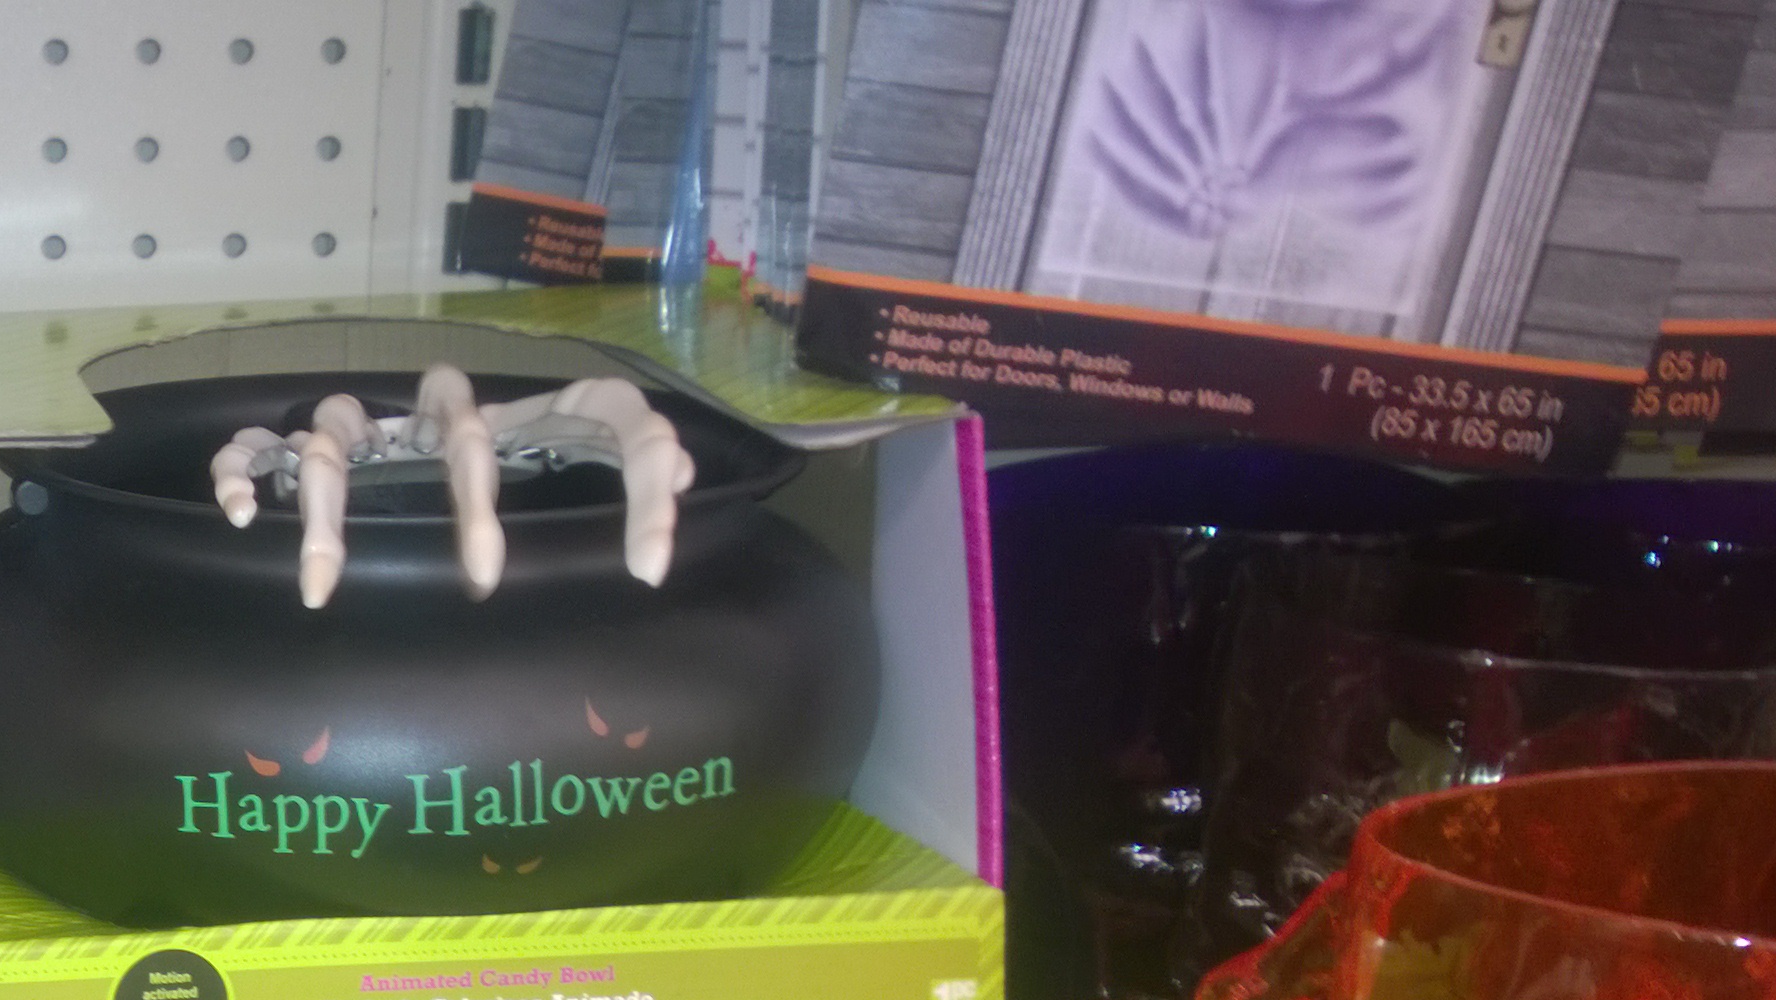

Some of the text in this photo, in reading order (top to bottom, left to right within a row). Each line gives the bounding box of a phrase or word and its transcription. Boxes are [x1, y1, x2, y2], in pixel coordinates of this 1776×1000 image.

[892, 305, 990, 335] Reusable
[887, 331, 1131, 376] Made of Durable Plastic
[1656, 349, 1729, 382] 65 in
[883, 354, 957, 379] Perfect
[960, 359, 992, 380] for
[1069, 374, 1164, 403] Windows
[1168, 387, 1194, 407] or
[1197, 386, 1255, 416] Walls
[1319, 362, 1336, 393] 1
[1346, 365, 1387, 400] Pc
[1408, 374, 1470, 412] 33.5
[1471, 387, 1491, 415] x
[1496, 385, 1536, 419] 65
[1536, 388, 1565, 424] in
[1664, 385, 1722, 423] cm)
[1369, 404, 1555, 464] (85 x 165 cm)
[174, 755, 737, 860] Happy Halloween
[148, 970, 193, 985] Motion
[359, 963, 617, 993] Animated Candy Bowl
